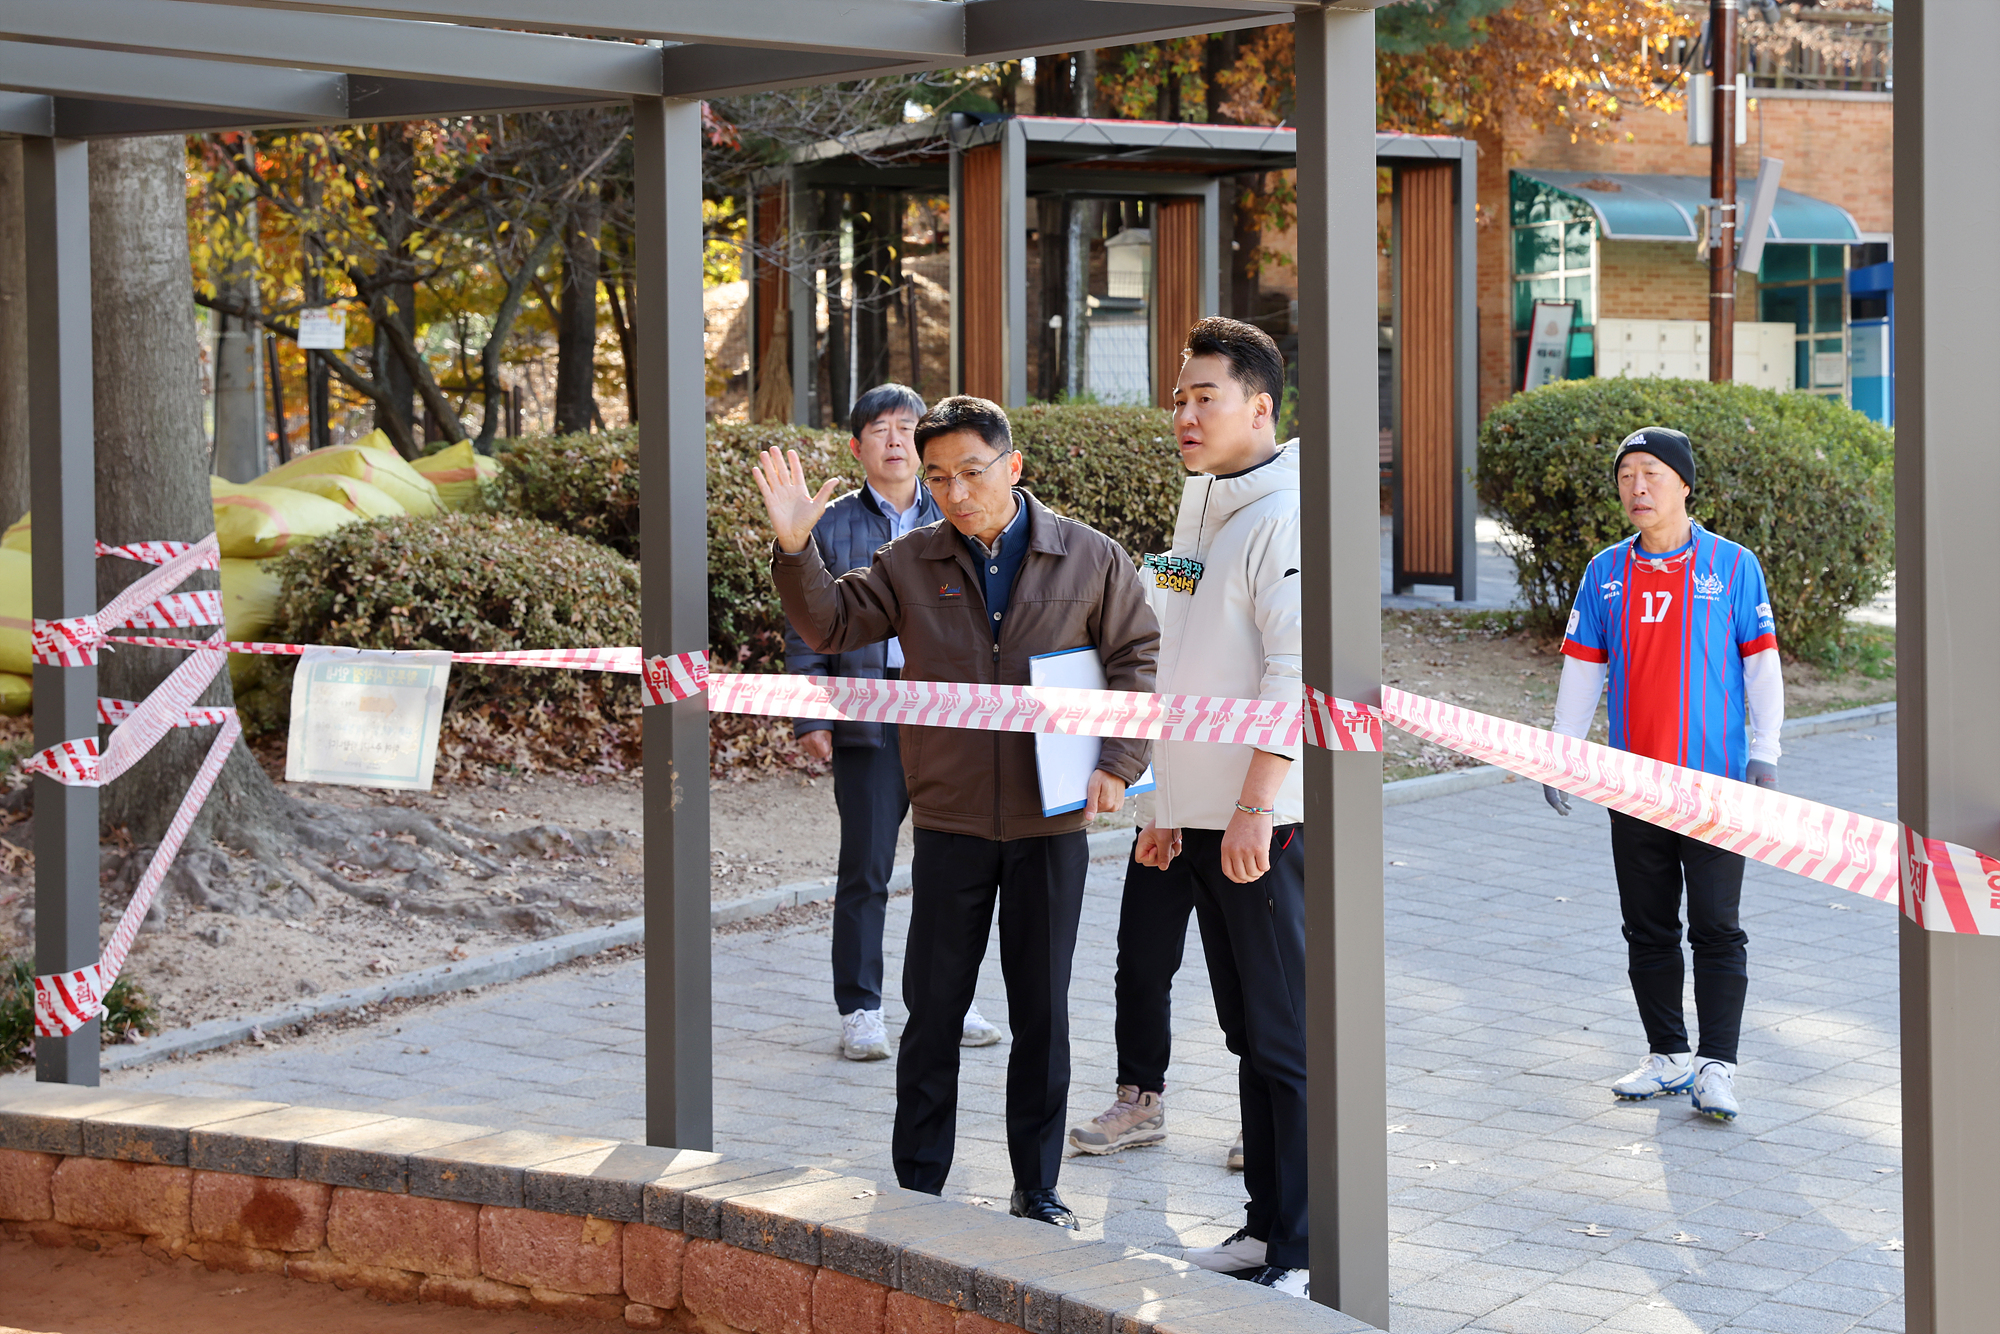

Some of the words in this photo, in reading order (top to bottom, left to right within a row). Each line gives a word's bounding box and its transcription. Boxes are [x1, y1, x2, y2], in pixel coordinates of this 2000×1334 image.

[1143, 553, 1203, 580] 도봉구청장
[1155, 573, 1194, 595] 오언석
[1640, 590, 1673, 623] 17
